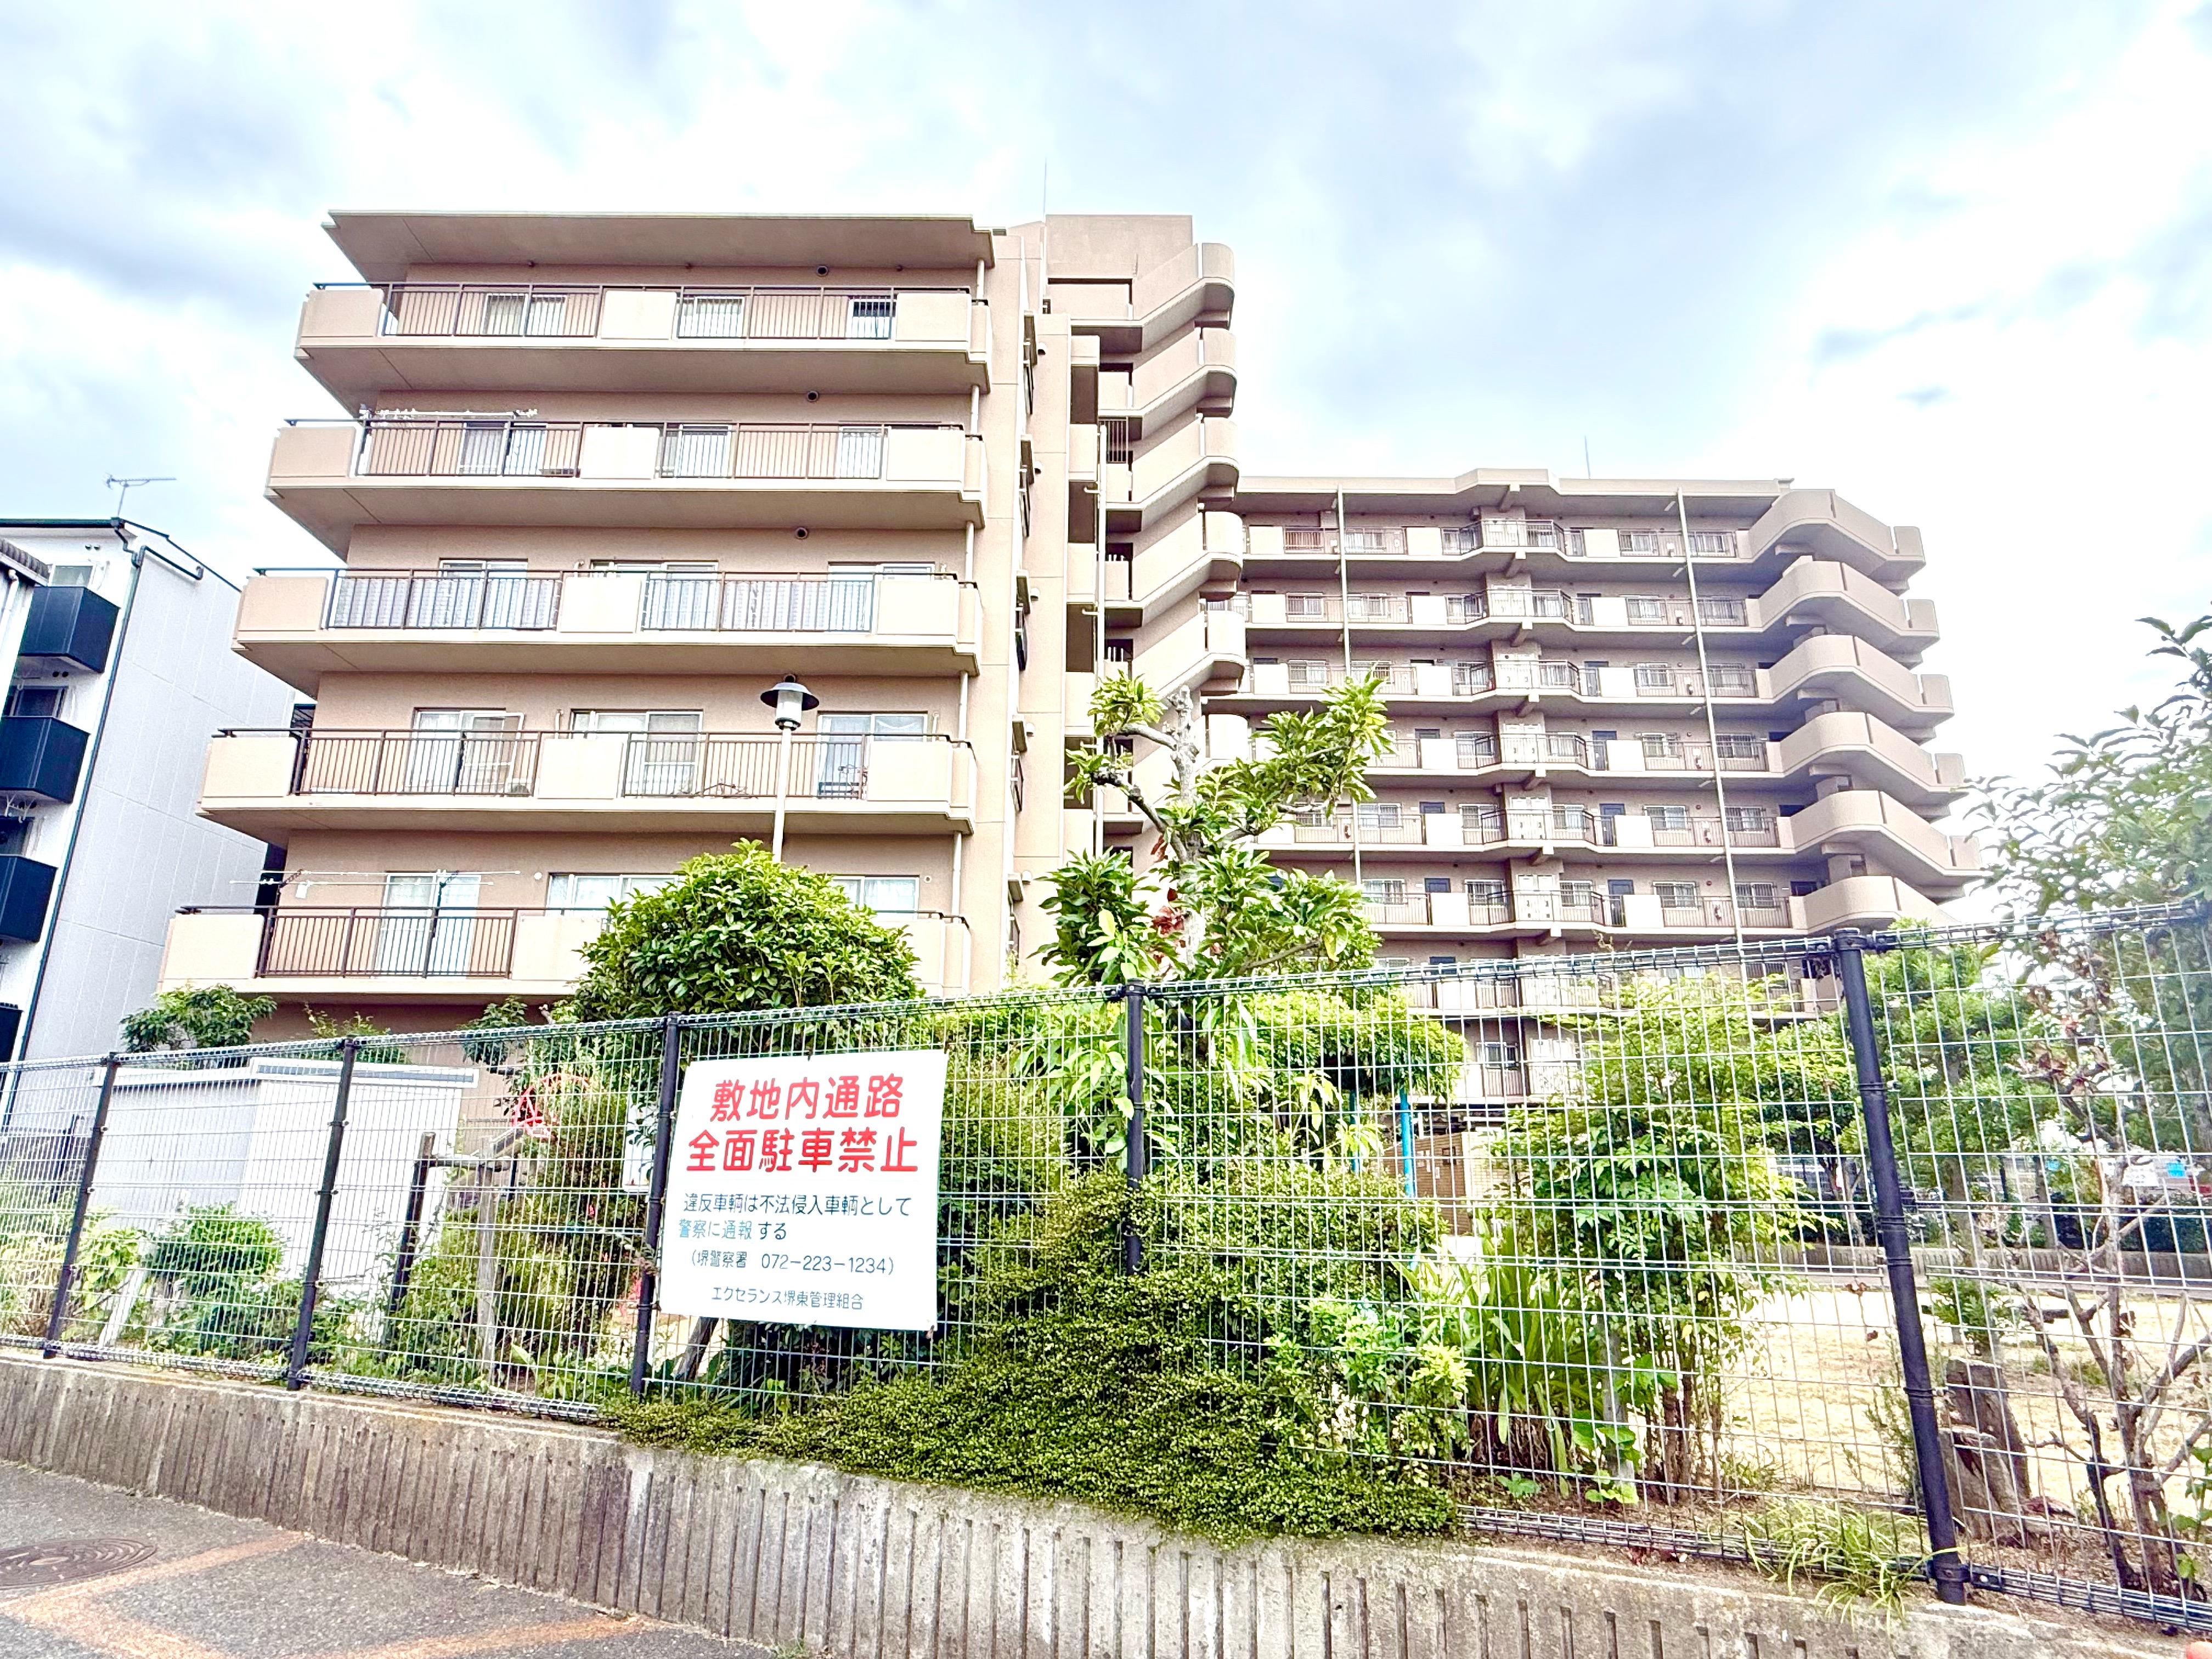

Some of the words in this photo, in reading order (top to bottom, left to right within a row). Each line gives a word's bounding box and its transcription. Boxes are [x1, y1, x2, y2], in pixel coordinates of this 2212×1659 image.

[709, 1073, 904, 1122] 敷地内通路
[686, 1126, 918, 1173] 全面駐車禁止
[712, 1286, 864, 1310] エクセランス堺東管理組合
